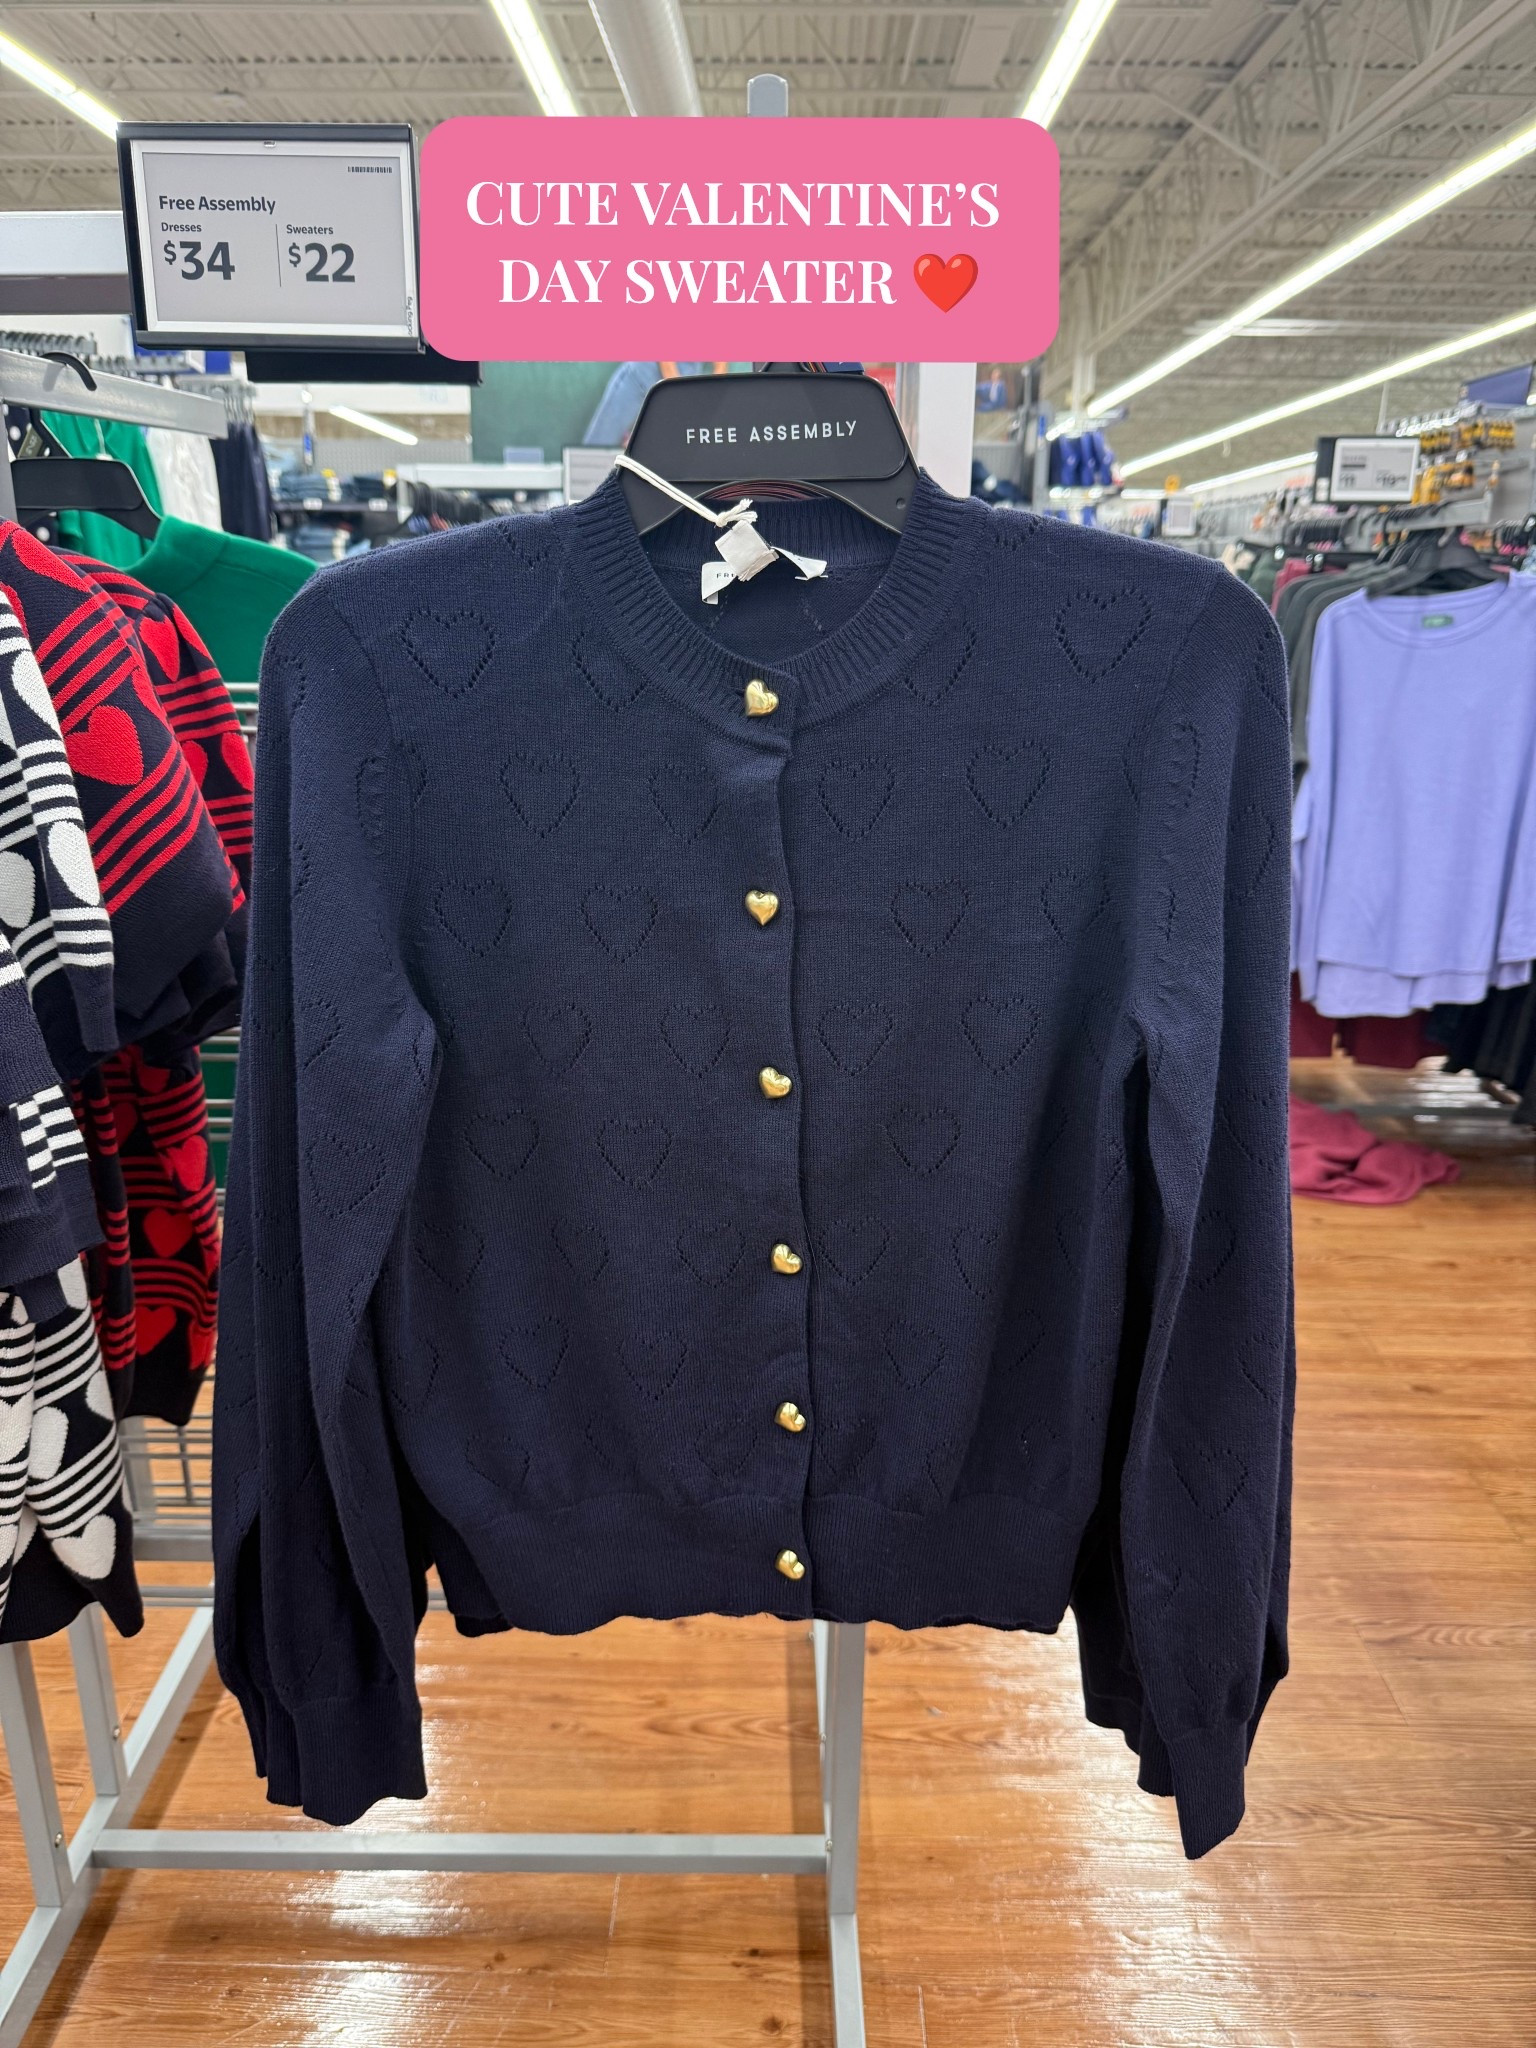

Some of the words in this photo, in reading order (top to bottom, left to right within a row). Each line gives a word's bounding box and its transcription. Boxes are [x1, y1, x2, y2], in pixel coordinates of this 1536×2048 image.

[158, 195, 195, 211] Free
[198, 195, 276, 215] Assembly
[160, 221, 202, 233] Dresses
[286, 224, 334, 235] Sweaters
[163, 239, 236, 281] $34
[288, 242, 356, 283] $22
[686, 427, 738, 445] FREE
[749, 420, 857, 443] ASSEMBLY
